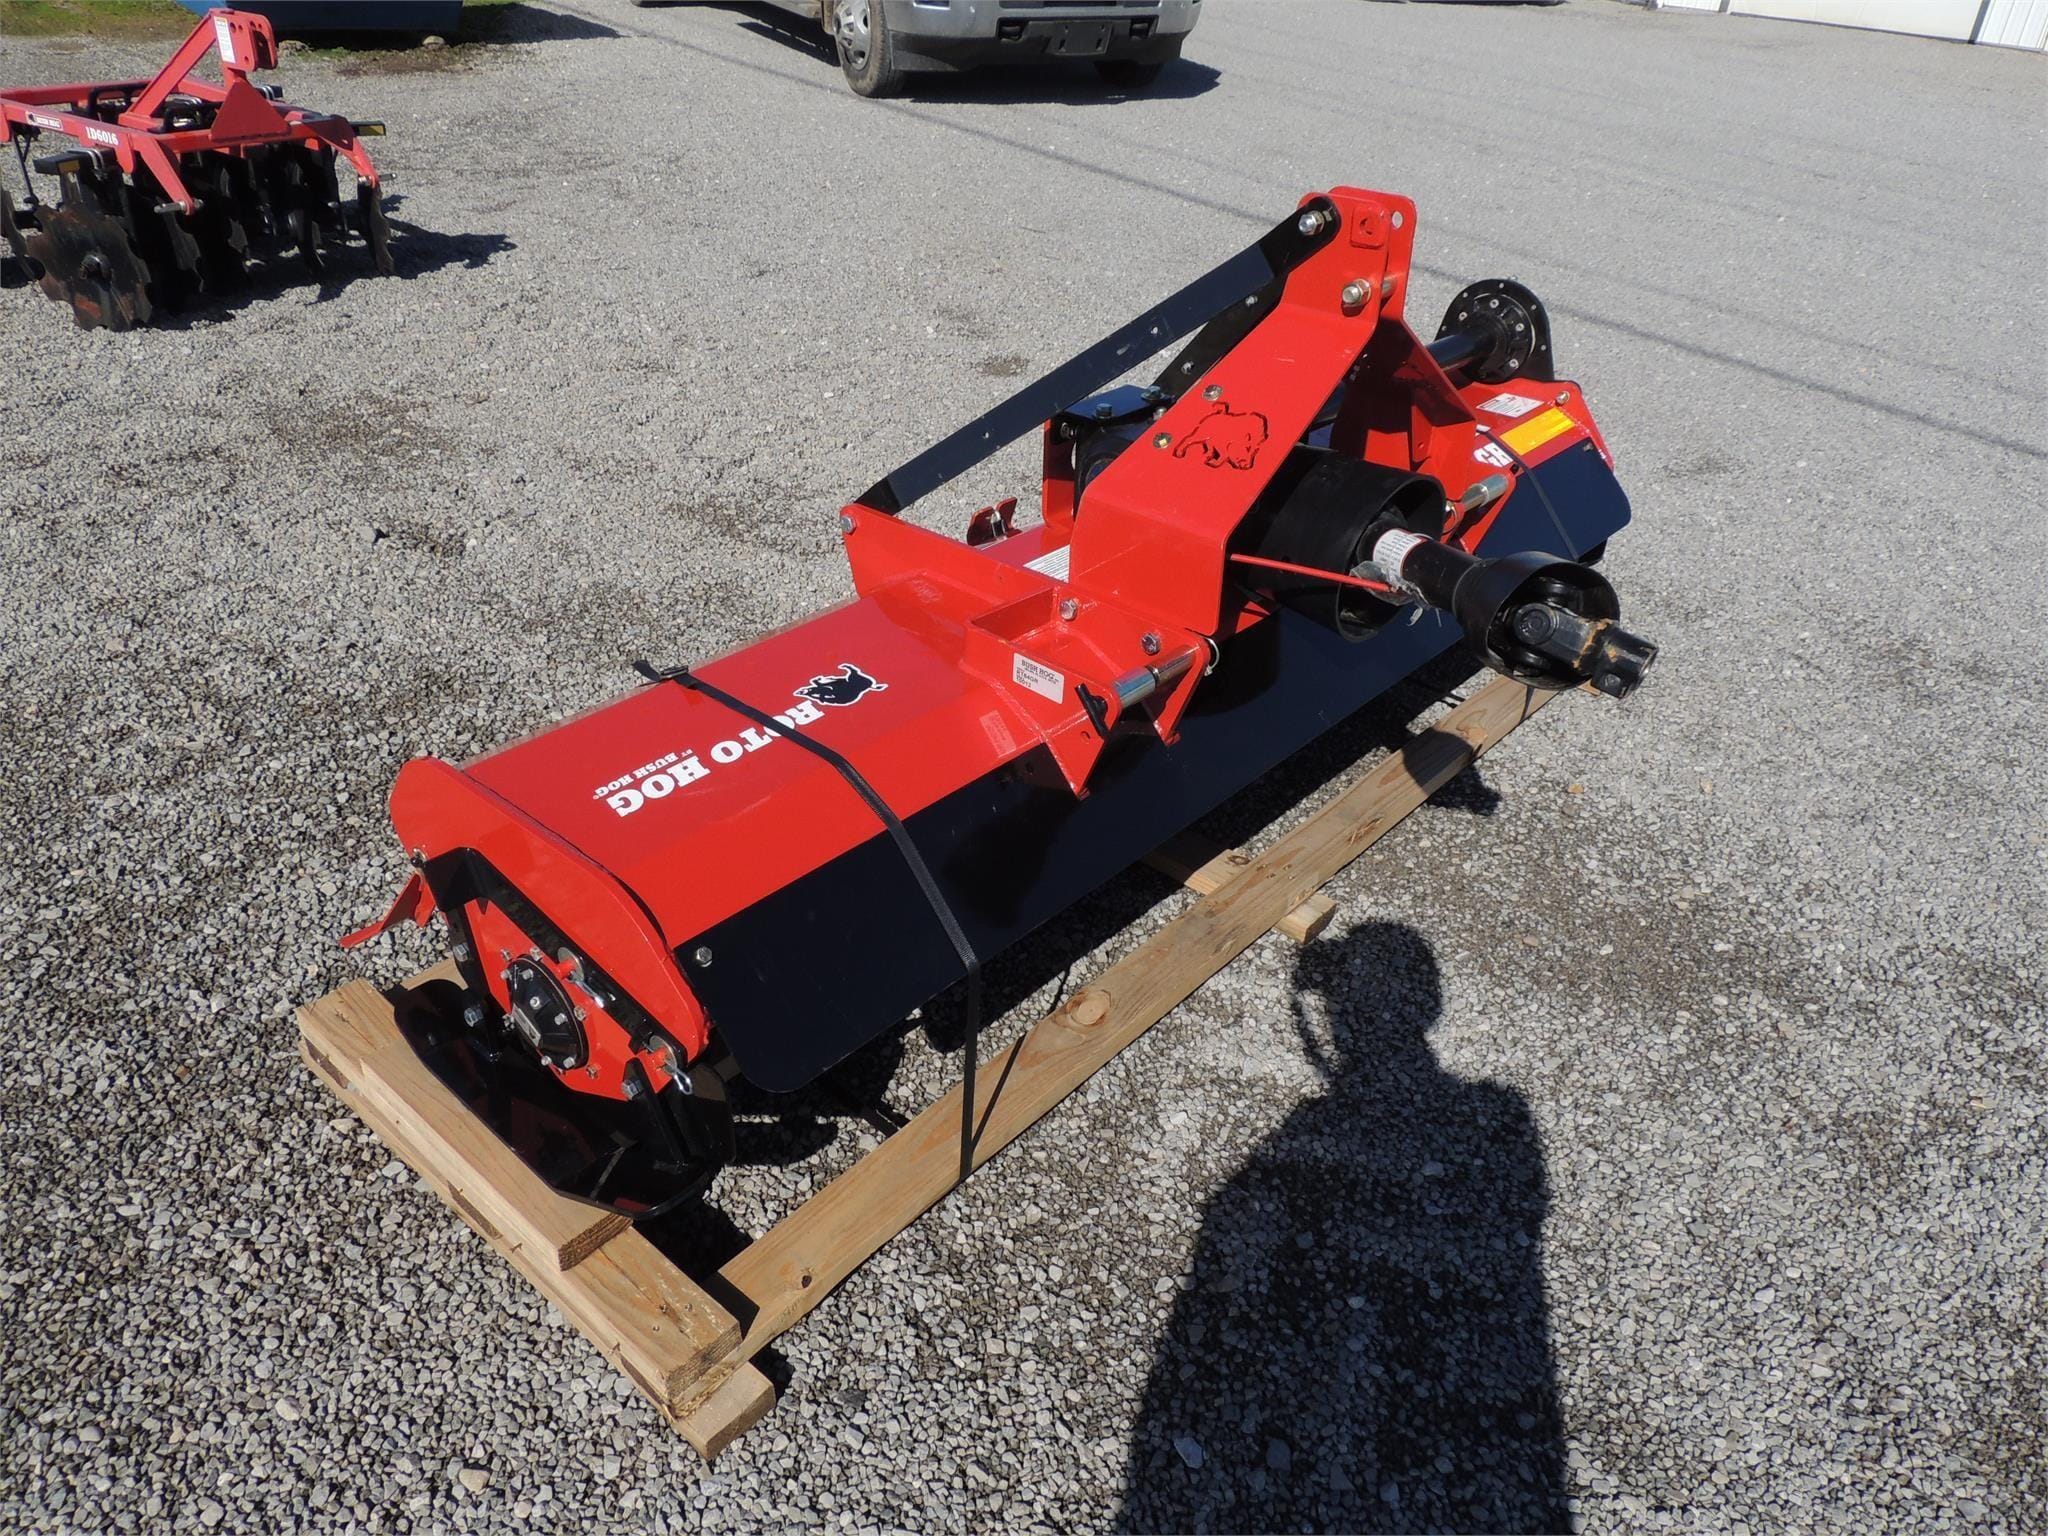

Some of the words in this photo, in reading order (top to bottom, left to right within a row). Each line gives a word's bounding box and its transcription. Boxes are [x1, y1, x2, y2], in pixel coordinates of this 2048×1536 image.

[1021, 659, 1038, 673] BUSH
[1039, 668, 1055, 679] HOG
[710, 700, 825, 764] ROTO
[606, 755, 711, 818] HOG
[632, 752, 679, 779] BUSH
